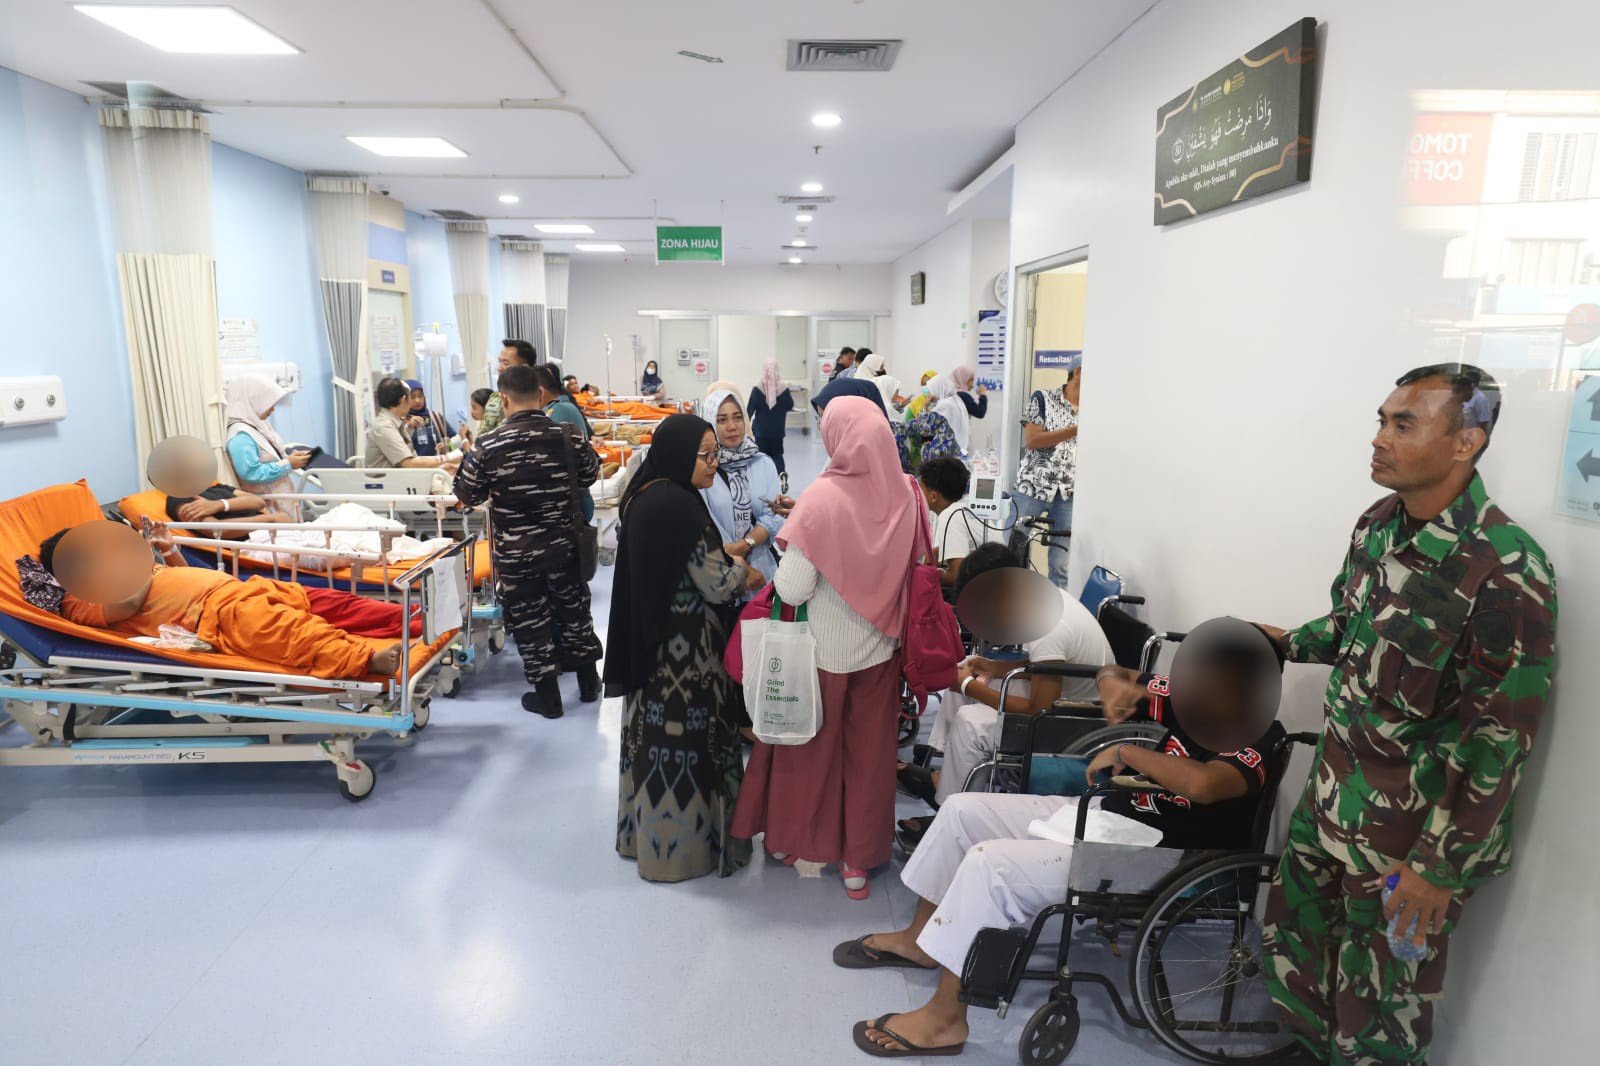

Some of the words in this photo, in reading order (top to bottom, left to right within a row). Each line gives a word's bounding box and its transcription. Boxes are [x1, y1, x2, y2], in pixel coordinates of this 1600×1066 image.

[1216, 157, 1228, 171] yang
[660, 239, 688, 249] ZONA
[691, 239, 719, 249] HIJAU
[766, 679, 785, 687] Grind
[767, 686, 779, 694] The
[765, 694, 799, 703] Essentials
